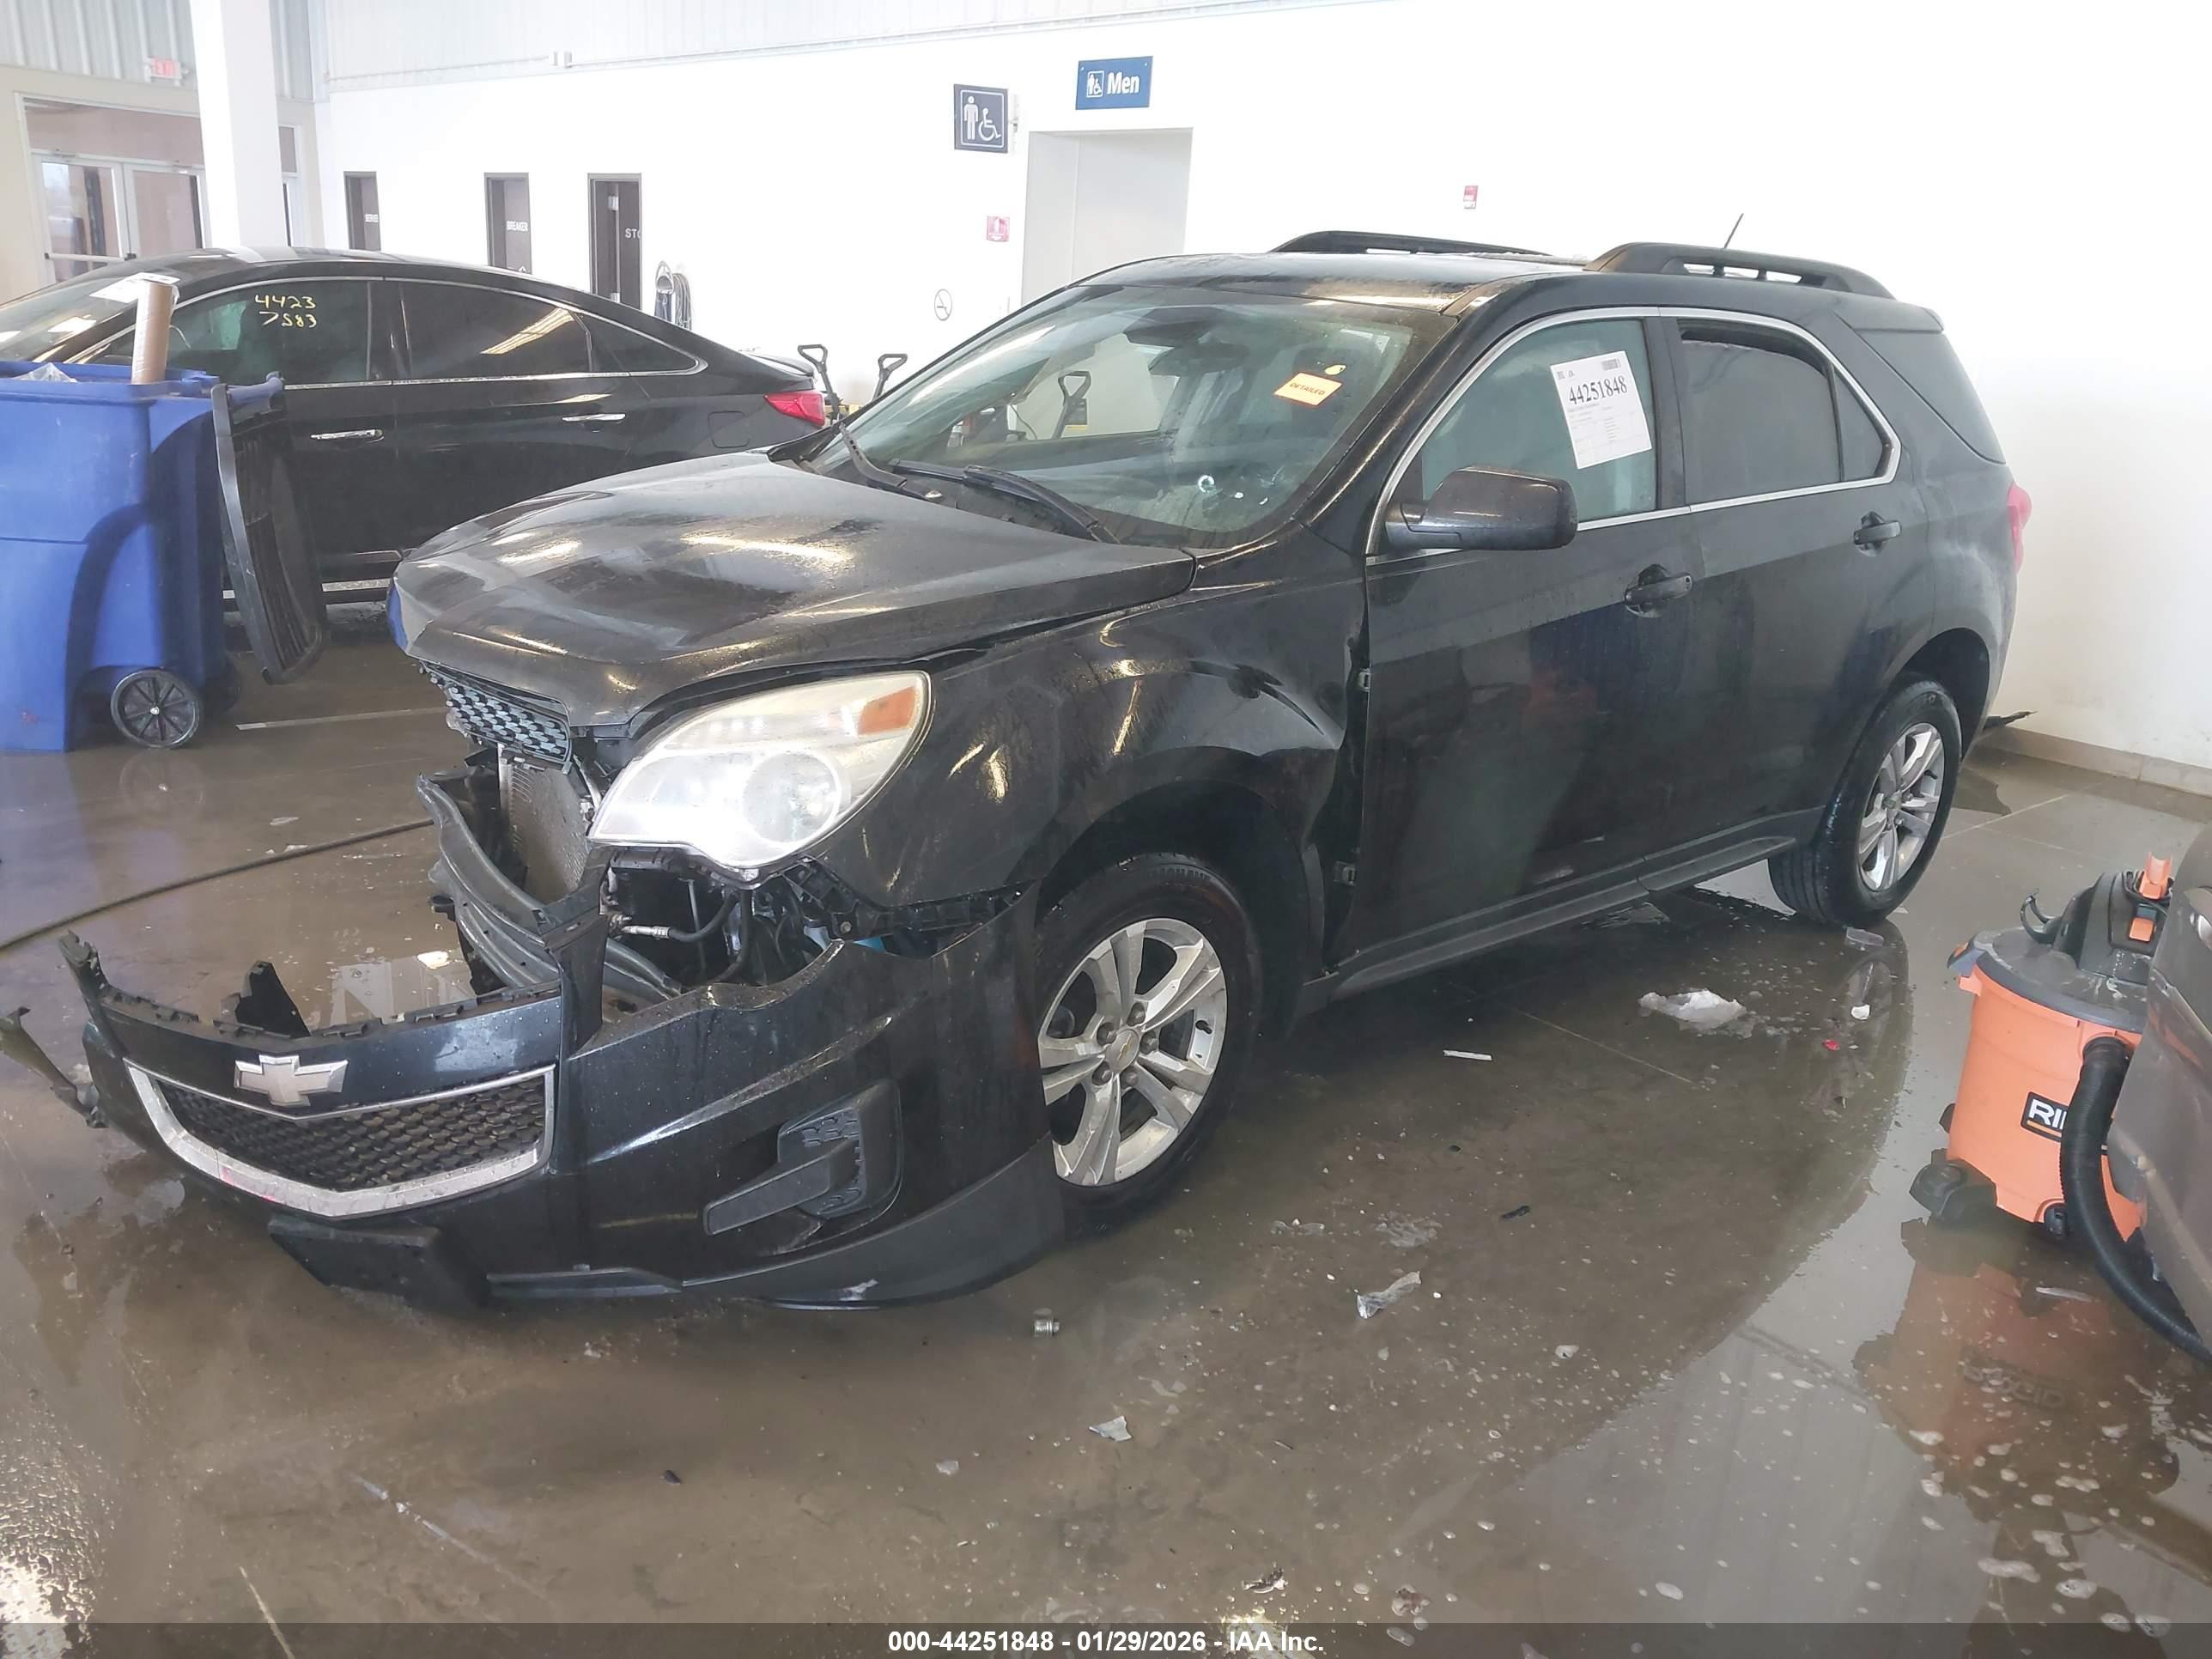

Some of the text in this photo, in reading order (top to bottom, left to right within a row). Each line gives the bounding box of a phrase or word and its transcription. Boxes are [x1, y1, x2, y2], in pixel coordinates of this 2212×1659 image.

[1107, 71, 1140, 94] Men
[255, 295, 316, 309] 4423
[1289, 382, 1326, 396] DETAILED
[1568, 375, 1627, 405] 44251848
